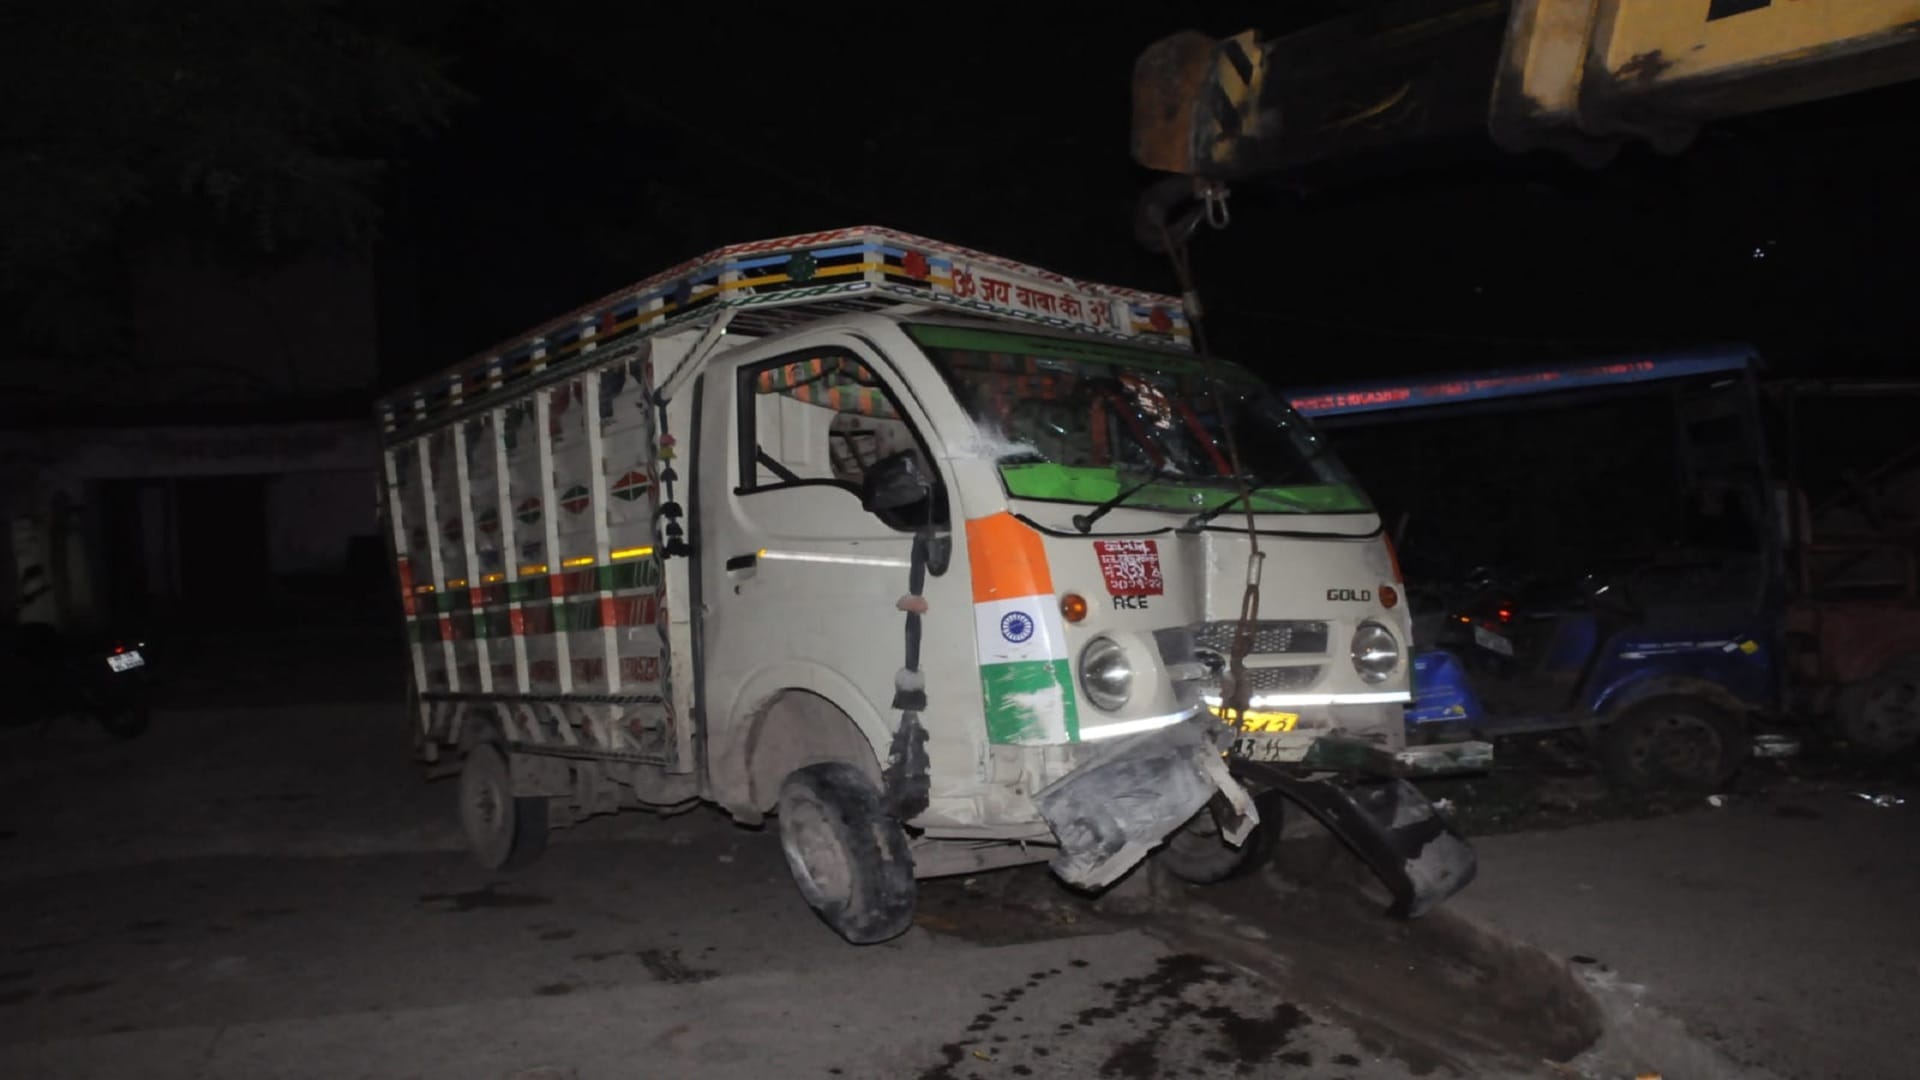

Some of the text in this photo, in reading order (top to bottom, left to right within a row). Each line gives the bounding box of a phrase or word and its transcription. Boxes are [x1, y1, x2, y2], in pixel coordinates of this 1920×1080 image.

[980, 277, 1011, 305] जय
[1016, 286, 1057, 313] बाबा
[1059, 294, 1082, 320] की
[1113, 595, 1149, 609] ACE
[1327, 588, 1371, 602] GOLD
